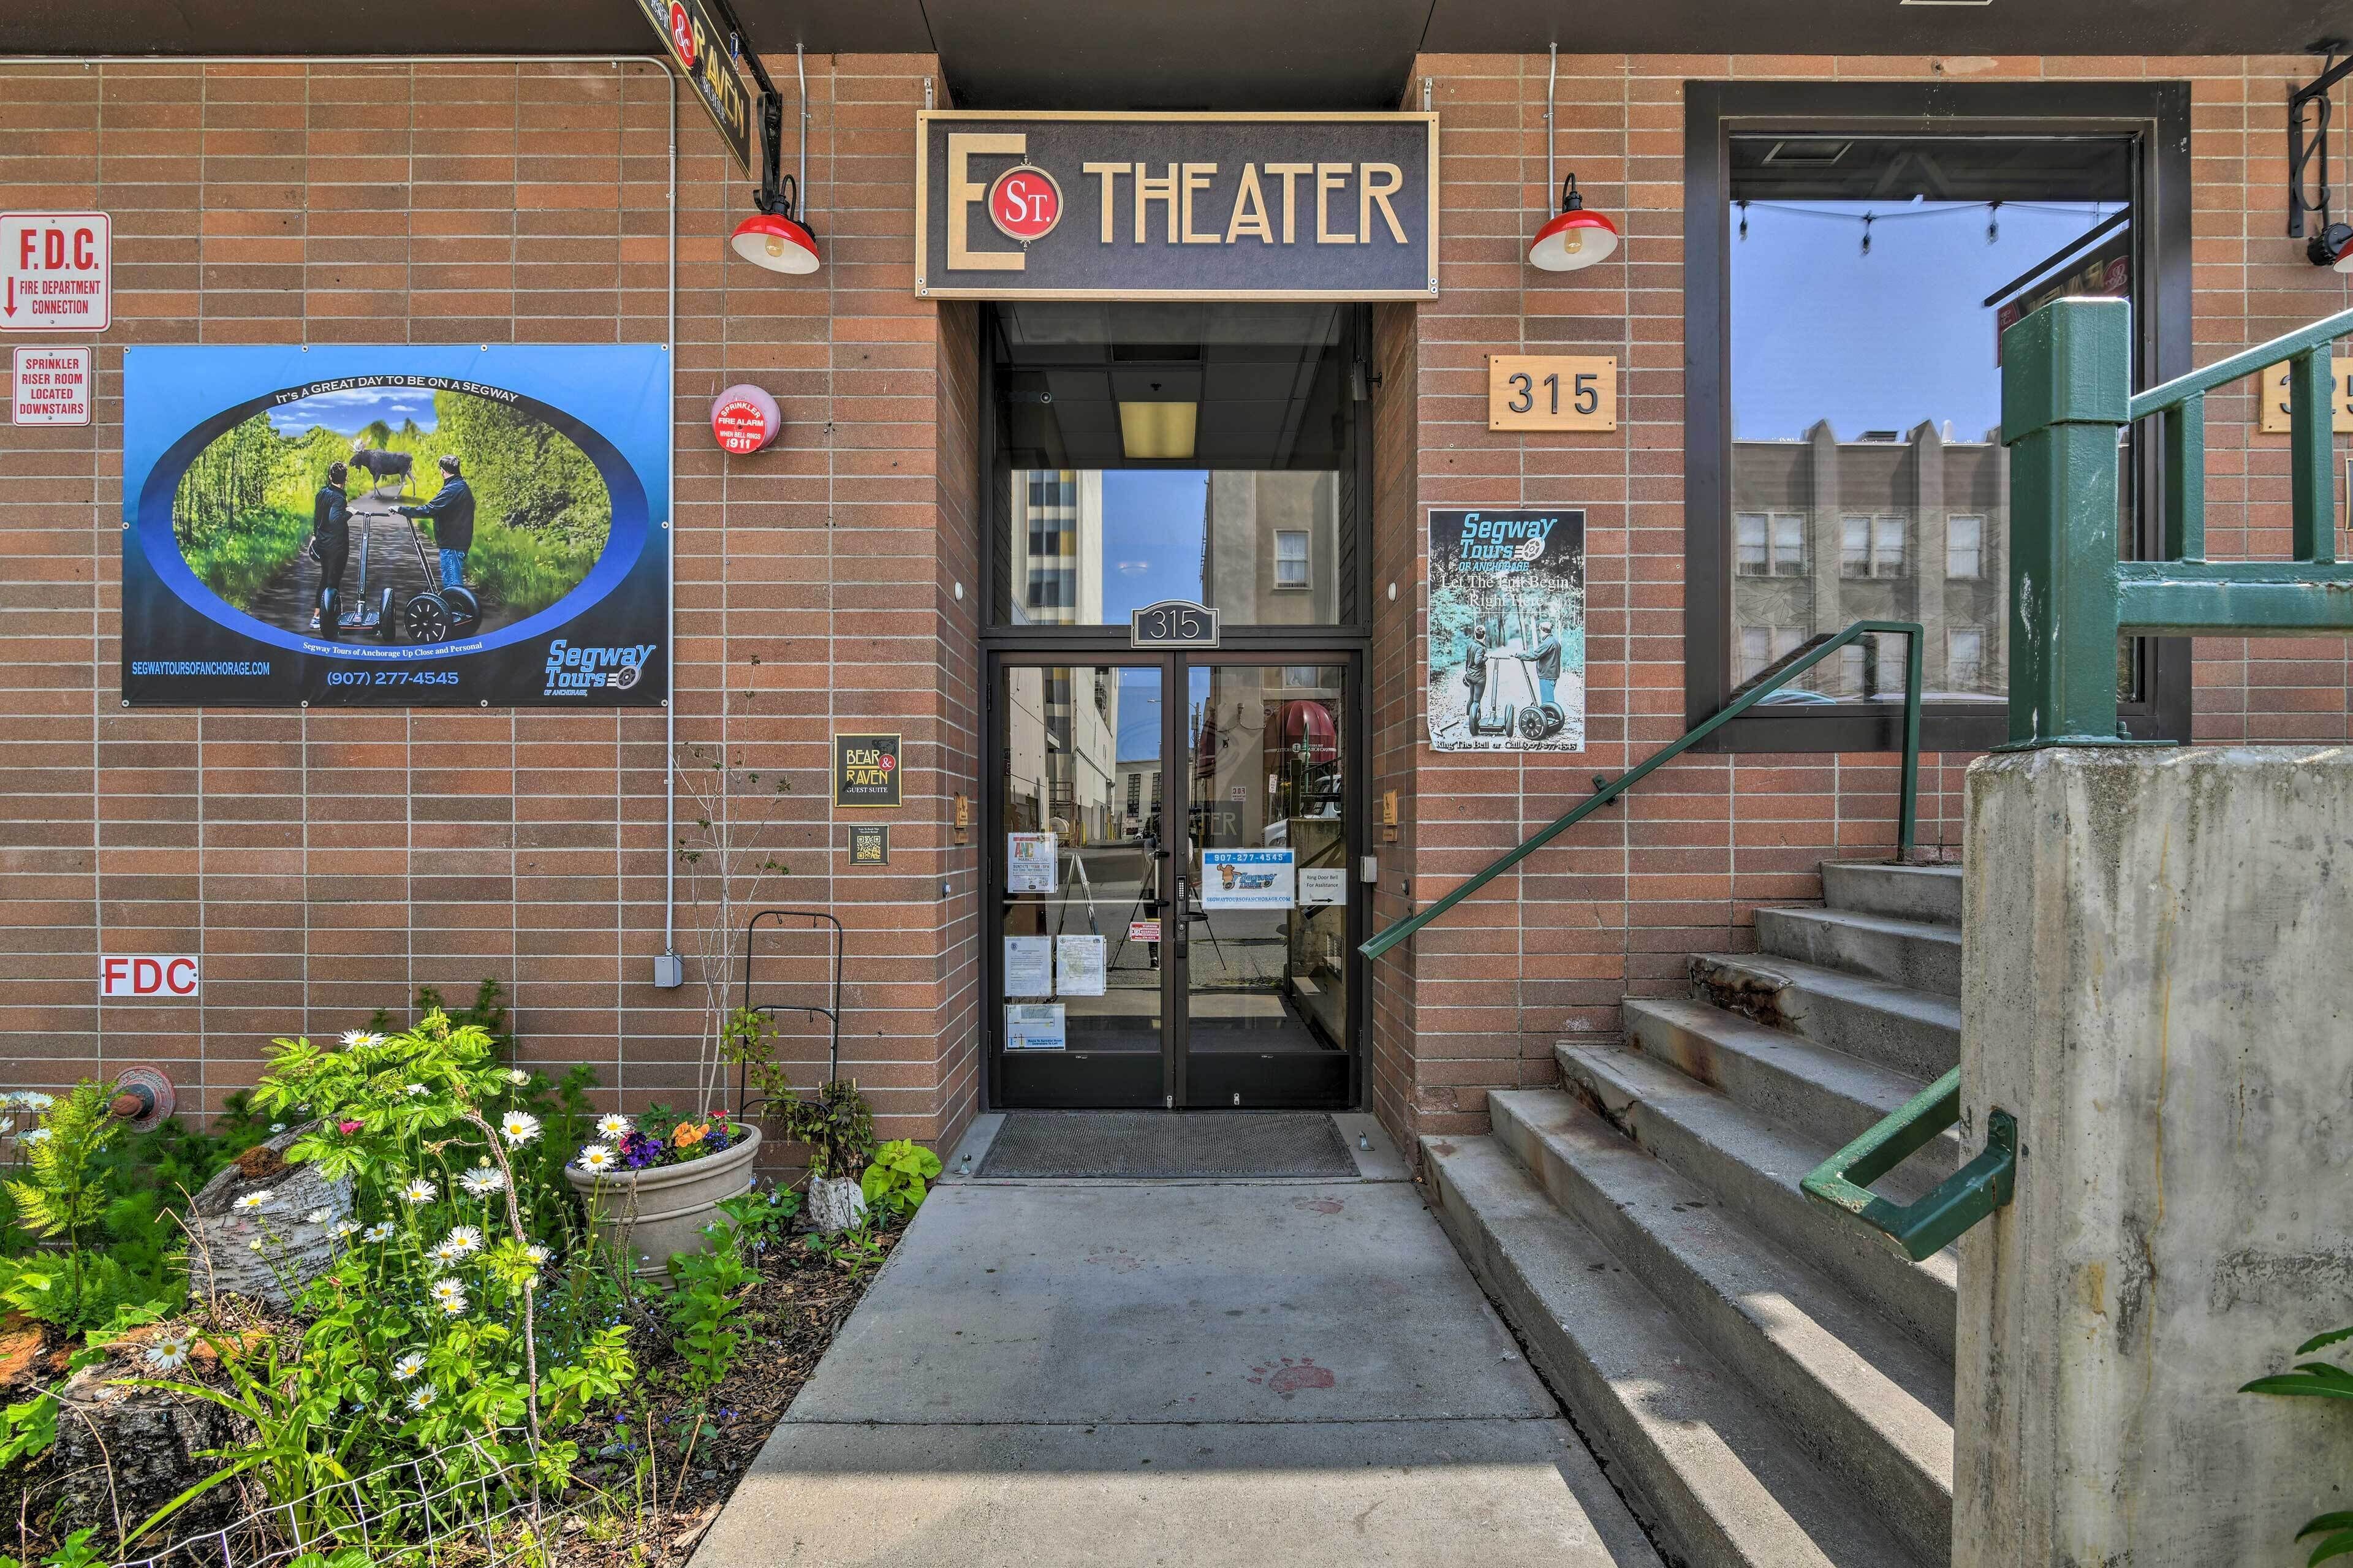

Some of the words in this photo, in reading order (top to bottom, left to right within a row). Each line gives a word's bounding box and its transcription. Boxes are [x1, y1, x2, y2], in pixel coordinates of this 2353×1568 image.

[694, 17, 744, 139] RAVEN
[947, 133, 1027, 270] E
[1083, 162, 1408, 244] THEATER
[20, 229, 99, 270] F.D.C.
[20, 281, 38, 294] FIRE
[42, 281, 100, 294] DEPARTMENT
[32, 300, 88, 314] CONNECTION
[26, 358, 79, 369] SPRINKLER
[22, 374, 50, 384] RISER
[55, 374, 83, 384] ROOM
[31, 388, 73, 400] LOCATED
[301, 388, 309, 396] A
[311, 378, 355, 394] GREAT
[358, 376, 385, 386] DAY
[385, 376, 403, 385] TO
[407, 376, 425, 387] BE
[428, 377, 449, 389] ON
[452, 380, 460, 390] A
[461, 382, 519, 403] SEGWAY
[1509, 373, 1598, 414] 315
[20, 403, 83, 414] DOWNSTAIRS
[721, 402, 760, 419] SPRINKLER
[730, 438, 750, 449] 911
[1461, 513, 1558, 544] Segway
[1460, 539, 1514, 558] Tours
[1458, 562, 1471, 571] OF
[1473, 561, 1529, 572] ANCHORAGE
[1441, 575, 1463, 588] Let
[1468, 575, 1495, 588] The
[1528, 575, 1574, 591] Begin!
[1469, 593, 1506, 609] Right
[1512, 594, 1544, 606] Here
[1150, 610, 1199, 638] 315
[303, 642, 331, 654] Segway
[332, 646, 352, 655] Tours
[362, 649, 400, 658] Anchorage
[450, 642, 482, 653] Personal
[547, 639, 656, 673] Segway
[132, 661, 270, 675] SEGWAYTOURSOFANCHORAGE.COM
[327, 672, 371, 686] (907)
[375, 672, 459, 685] 277-4545
[545, 666, 607, 687] Tours
[1436, 741, 1453, 750] Ring
[847, 749, 880, 764] BEAR
[882, 757, 892, 768] &
[847, 770, 888, 784] RAVEN
[105, 958, 196, 994] FDC
